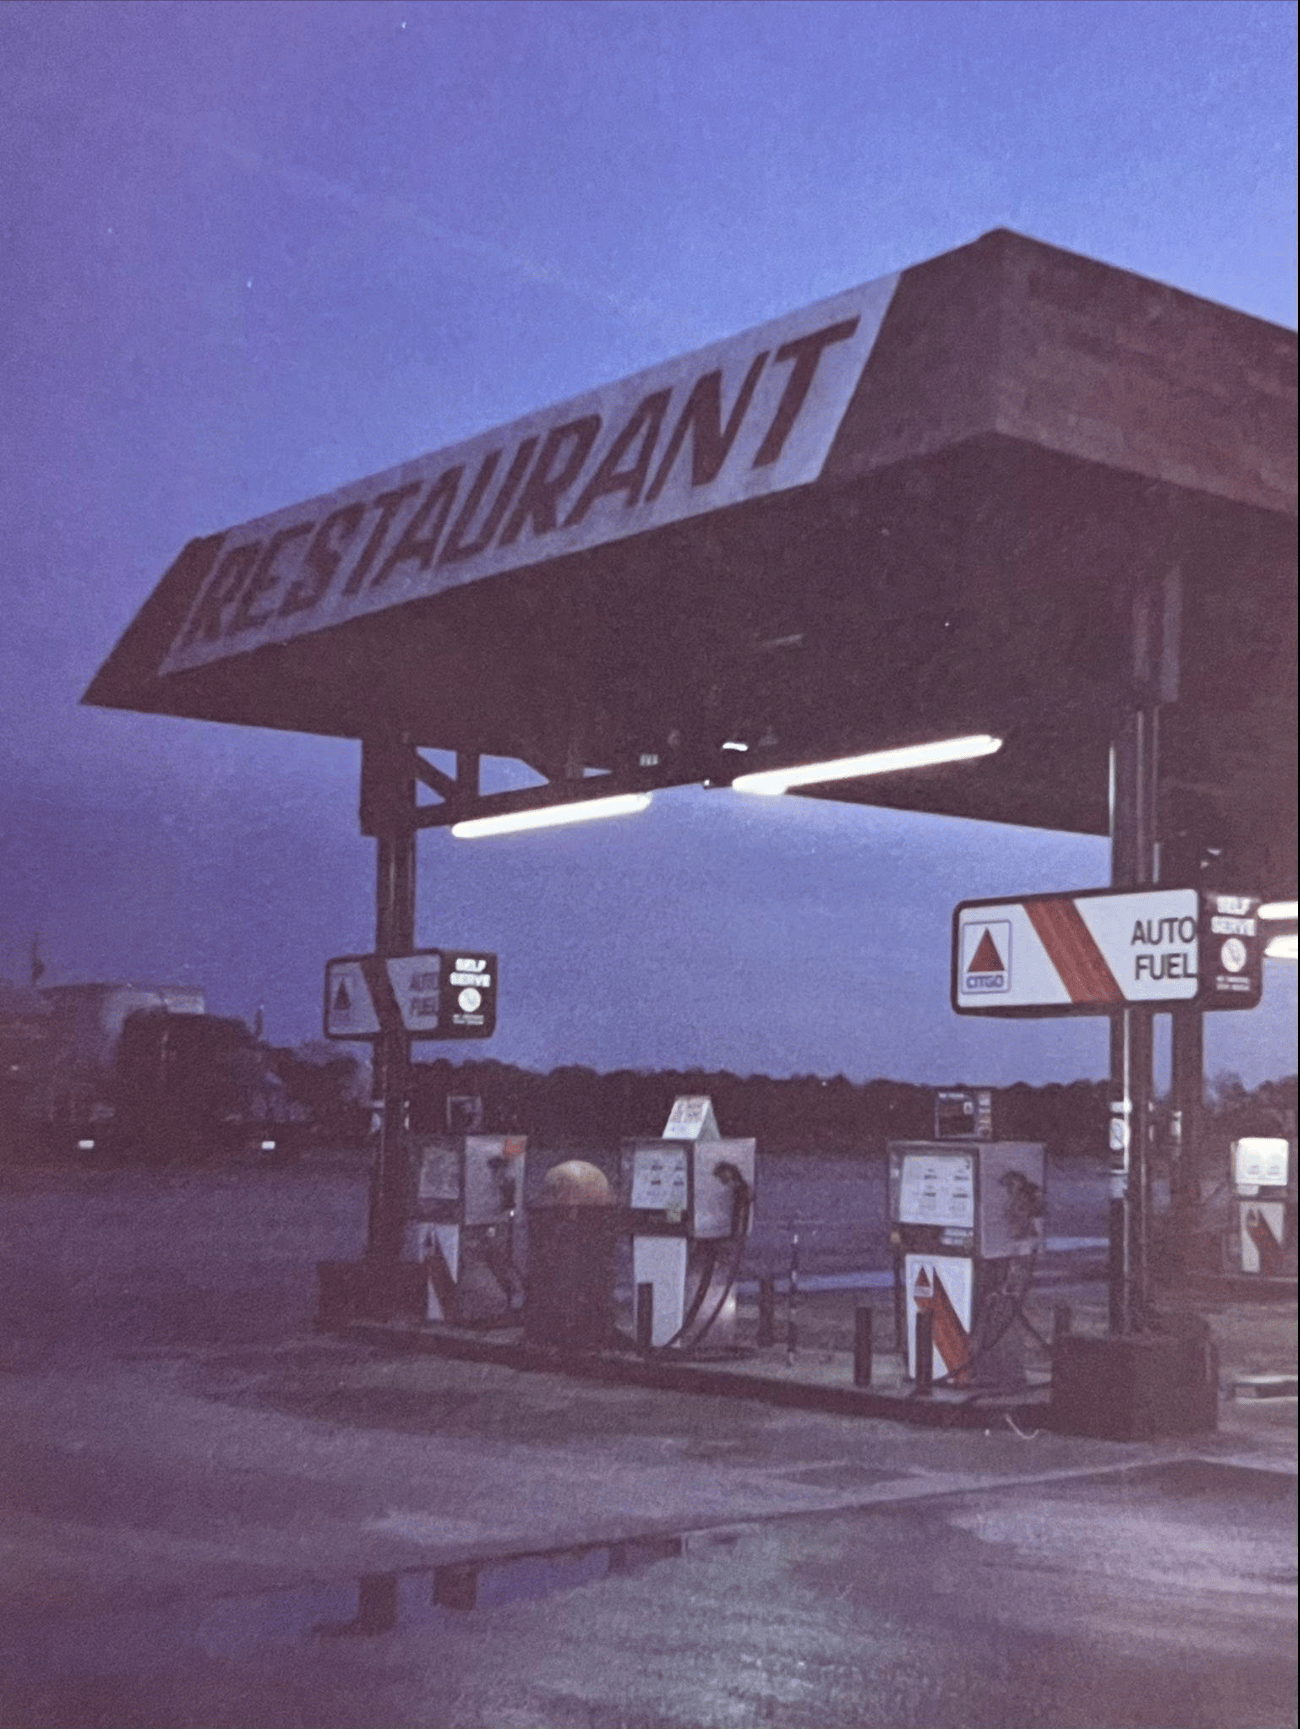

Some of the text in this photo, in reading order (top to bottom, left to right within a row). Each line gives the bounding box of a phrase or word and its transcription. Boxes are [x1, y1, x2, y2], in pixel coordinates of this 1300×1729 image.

[180, 315, 861, 643] RESTAURANT
[1131, 916, 1197, 945] AUTO
[1134, 952, 1198, 981] FUEL
[966, 974, 1004, 989] CITGO
